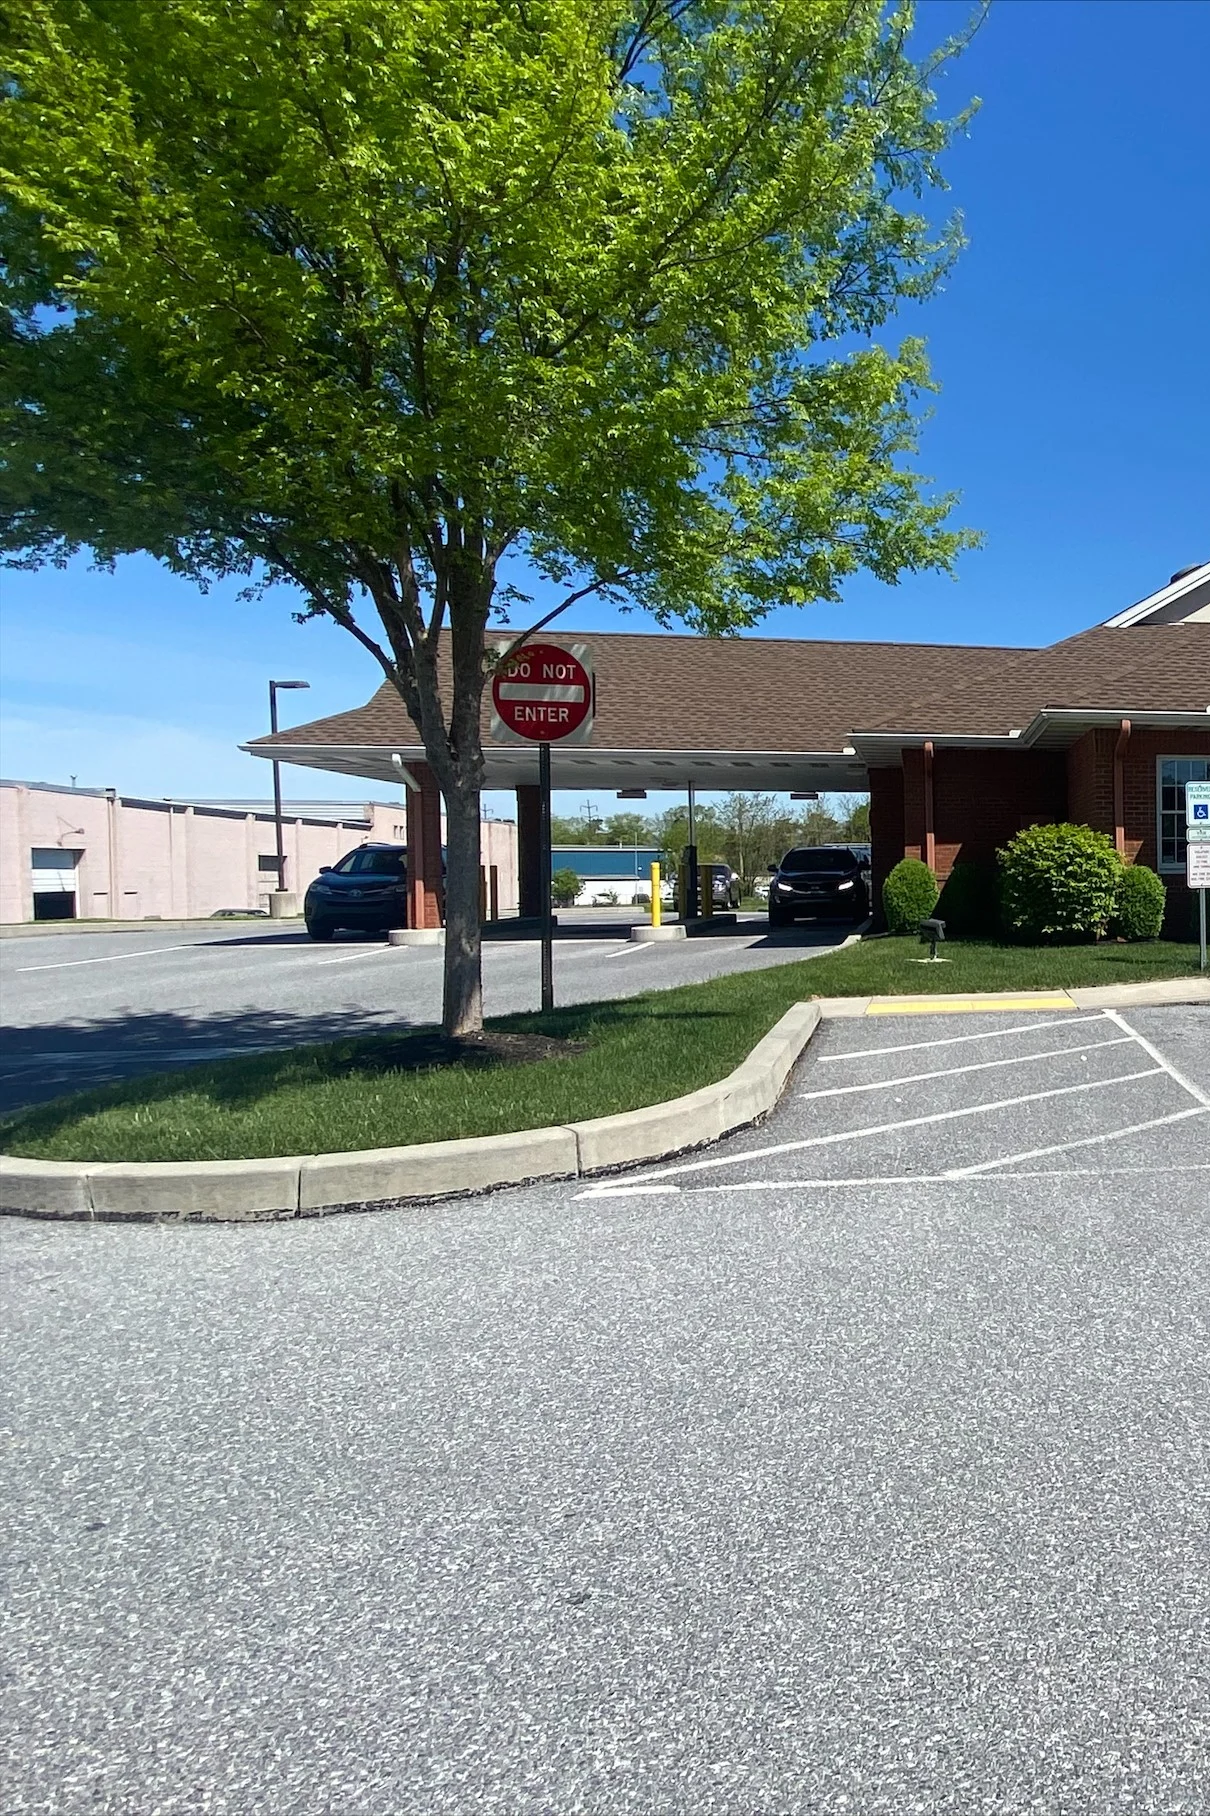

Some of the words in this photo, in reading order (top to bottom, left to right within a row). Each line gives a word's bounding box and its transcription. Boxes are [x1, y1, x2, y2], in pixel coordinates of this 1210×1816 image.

[507, 663, 531, 678] DO
[542, 664, 577, 680] NOT
[514, 706, 569, 723] ENTER
